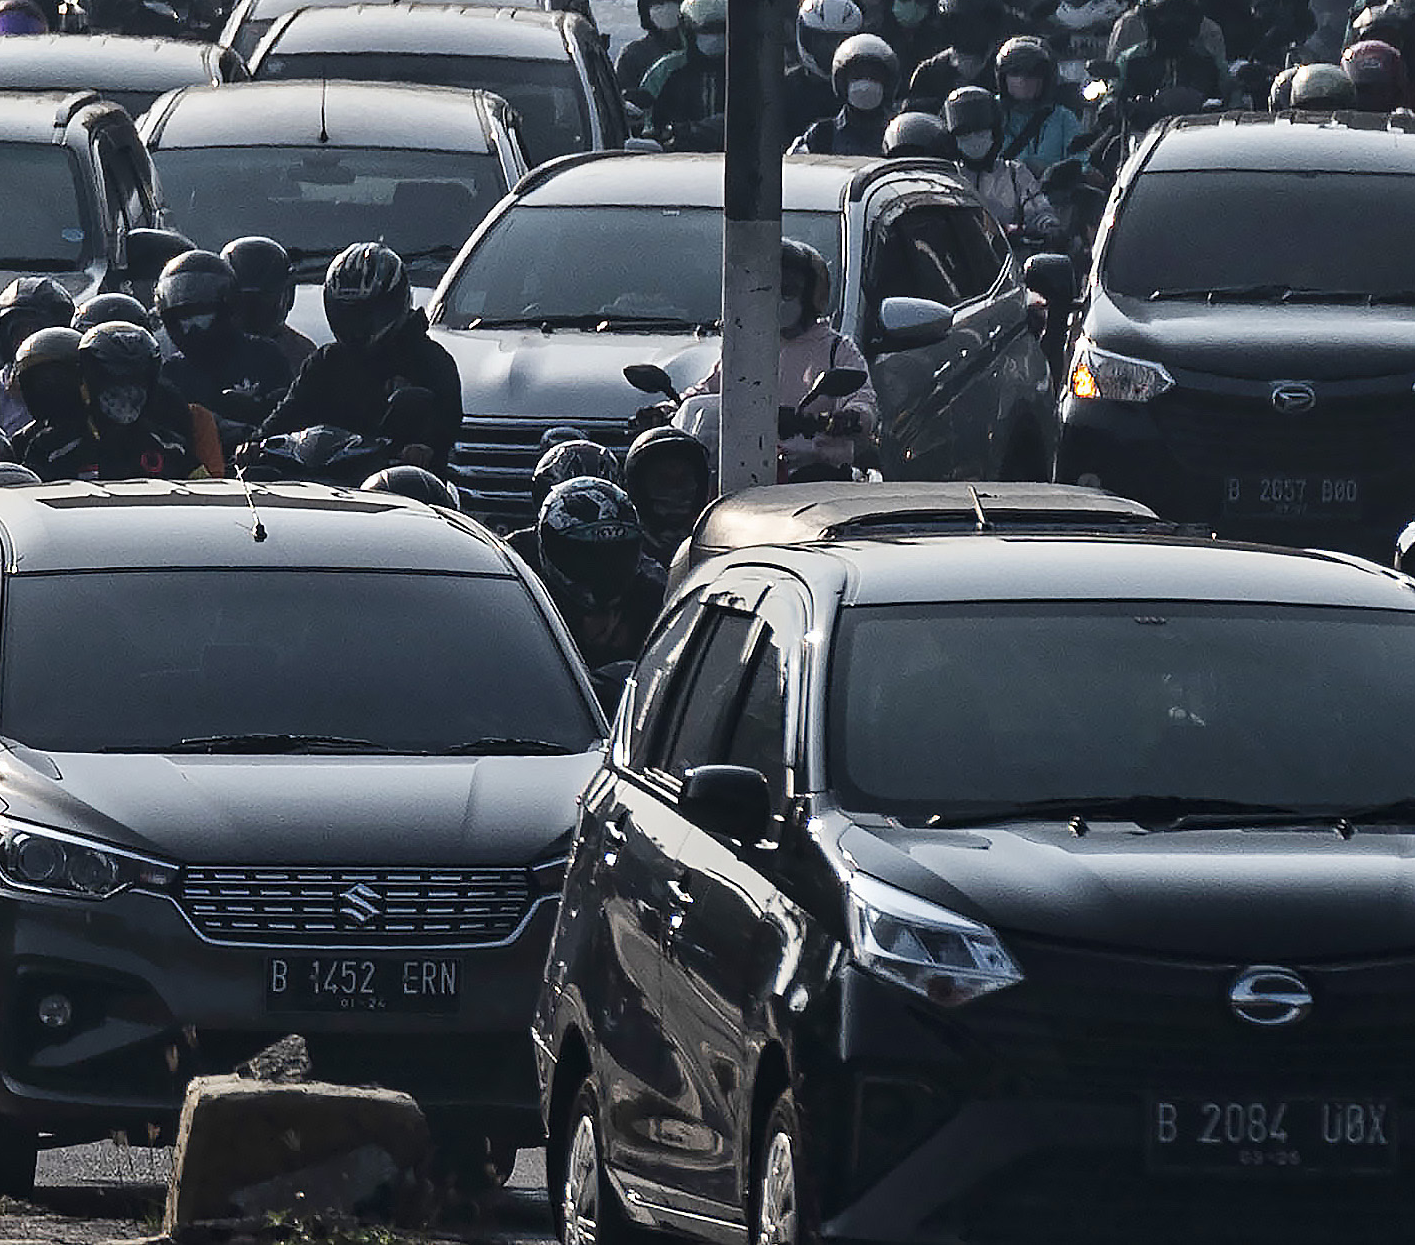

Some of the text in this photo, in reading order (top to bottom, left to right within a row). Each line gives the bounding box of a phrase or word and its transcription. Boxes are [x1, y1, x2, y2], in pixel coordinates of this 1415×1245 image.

[271, 958, 457, 995] B 1452 ERN
[1157, 1101, 1177, 1143] B
[1195, 1101, 1289, 1144] 2084
